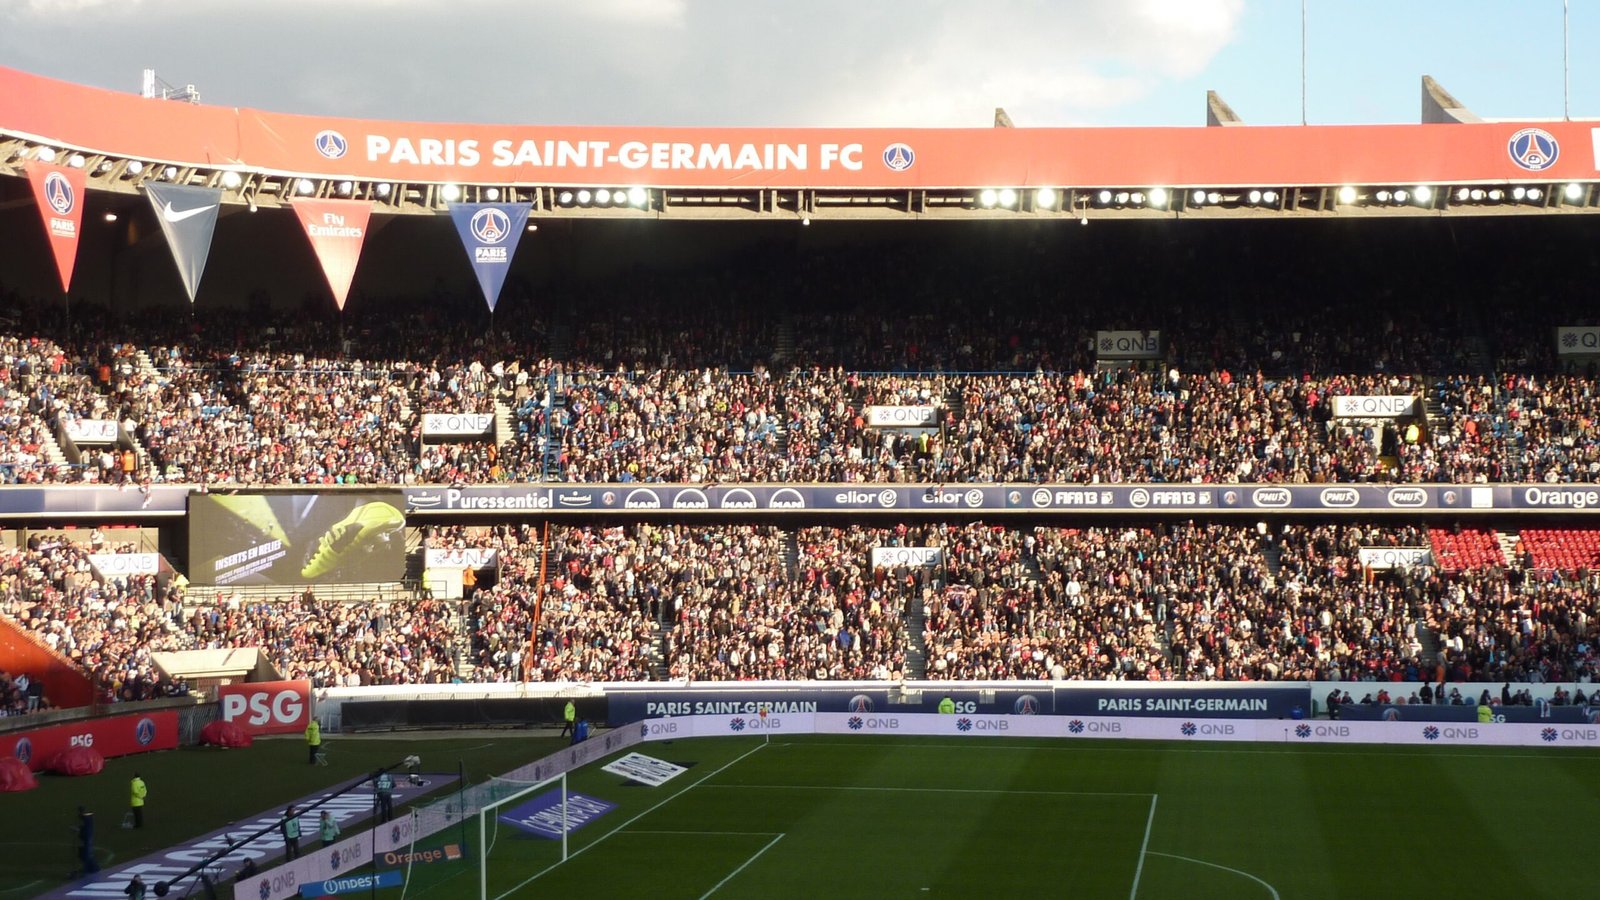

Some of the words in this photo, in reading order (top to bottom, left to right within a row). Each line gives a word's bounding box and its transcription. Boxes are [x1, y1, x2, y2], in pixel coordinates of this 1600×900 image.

[366, 134, 481, 167] PARIS
[492, 140, 807, 171] SAINT-GERMAIN
[820, 143, 863, 171] FC
[50, 218, 76, 232] PARIS
[323, 212, 344, 226] Fly
[308, 224, 363, 238] Emirates
[475, 246, 507, 258] PARIS
[1116, 337, 1157, 352] QNB
[1362, 398, 1406, 413] QNB
[893, 408, 932, 422] QNB
[447, 416, 490, 431] QNB
[447, 488, 553, 509] Puressentiel
[835, 489, 877, 504] elior
[922, 489, 963, 504] elior
[1525, 487, 1598, 507] Orange
[628, 500, 658, 509] MAN
[676, 500, 706, 509] MAN
[724, 500, 754, 509] MAN
[772, 500, 802, 509] MAN
[215, 551, 248, 571] INSERTS
[248, 546, 258, 560] EN
[258, 538, 283, 556] RELIEF
[897, 550, 937, 564] QNB
[1383, 551, 1425, 566] QNB
[113, 556, 153, 570] QNB
[223, 690, 304, 726] PSG
[646, 701, 691, 715] PARIS
[695, 700, 818, 714] SAINT-GERMAIN
[1098, 698, 1142, 711] PARIS
[1146, 698, 1268, 712] SAINT-GERMAIN
[651, 722, 677, 735] QNB
[748, 718, 781, 730] QNB
[866, 718, 899, 730] QNB
[975, 719, 1009, 731] QNB
[1088, 722, 1122, 733] QNB
[1200, 723, 1235, 735] QNB
[1315, 725, 1350, 737] QNB
[1444, 727, 1479, 739] QNB
[1561, 729, 1598, 741] QNB
[71, 733, 94, 748] PSG
[341, 842, 362, 864] QNB
[384, 848, 442, 865] Orange
[272, 870, 297, 894] QNB
